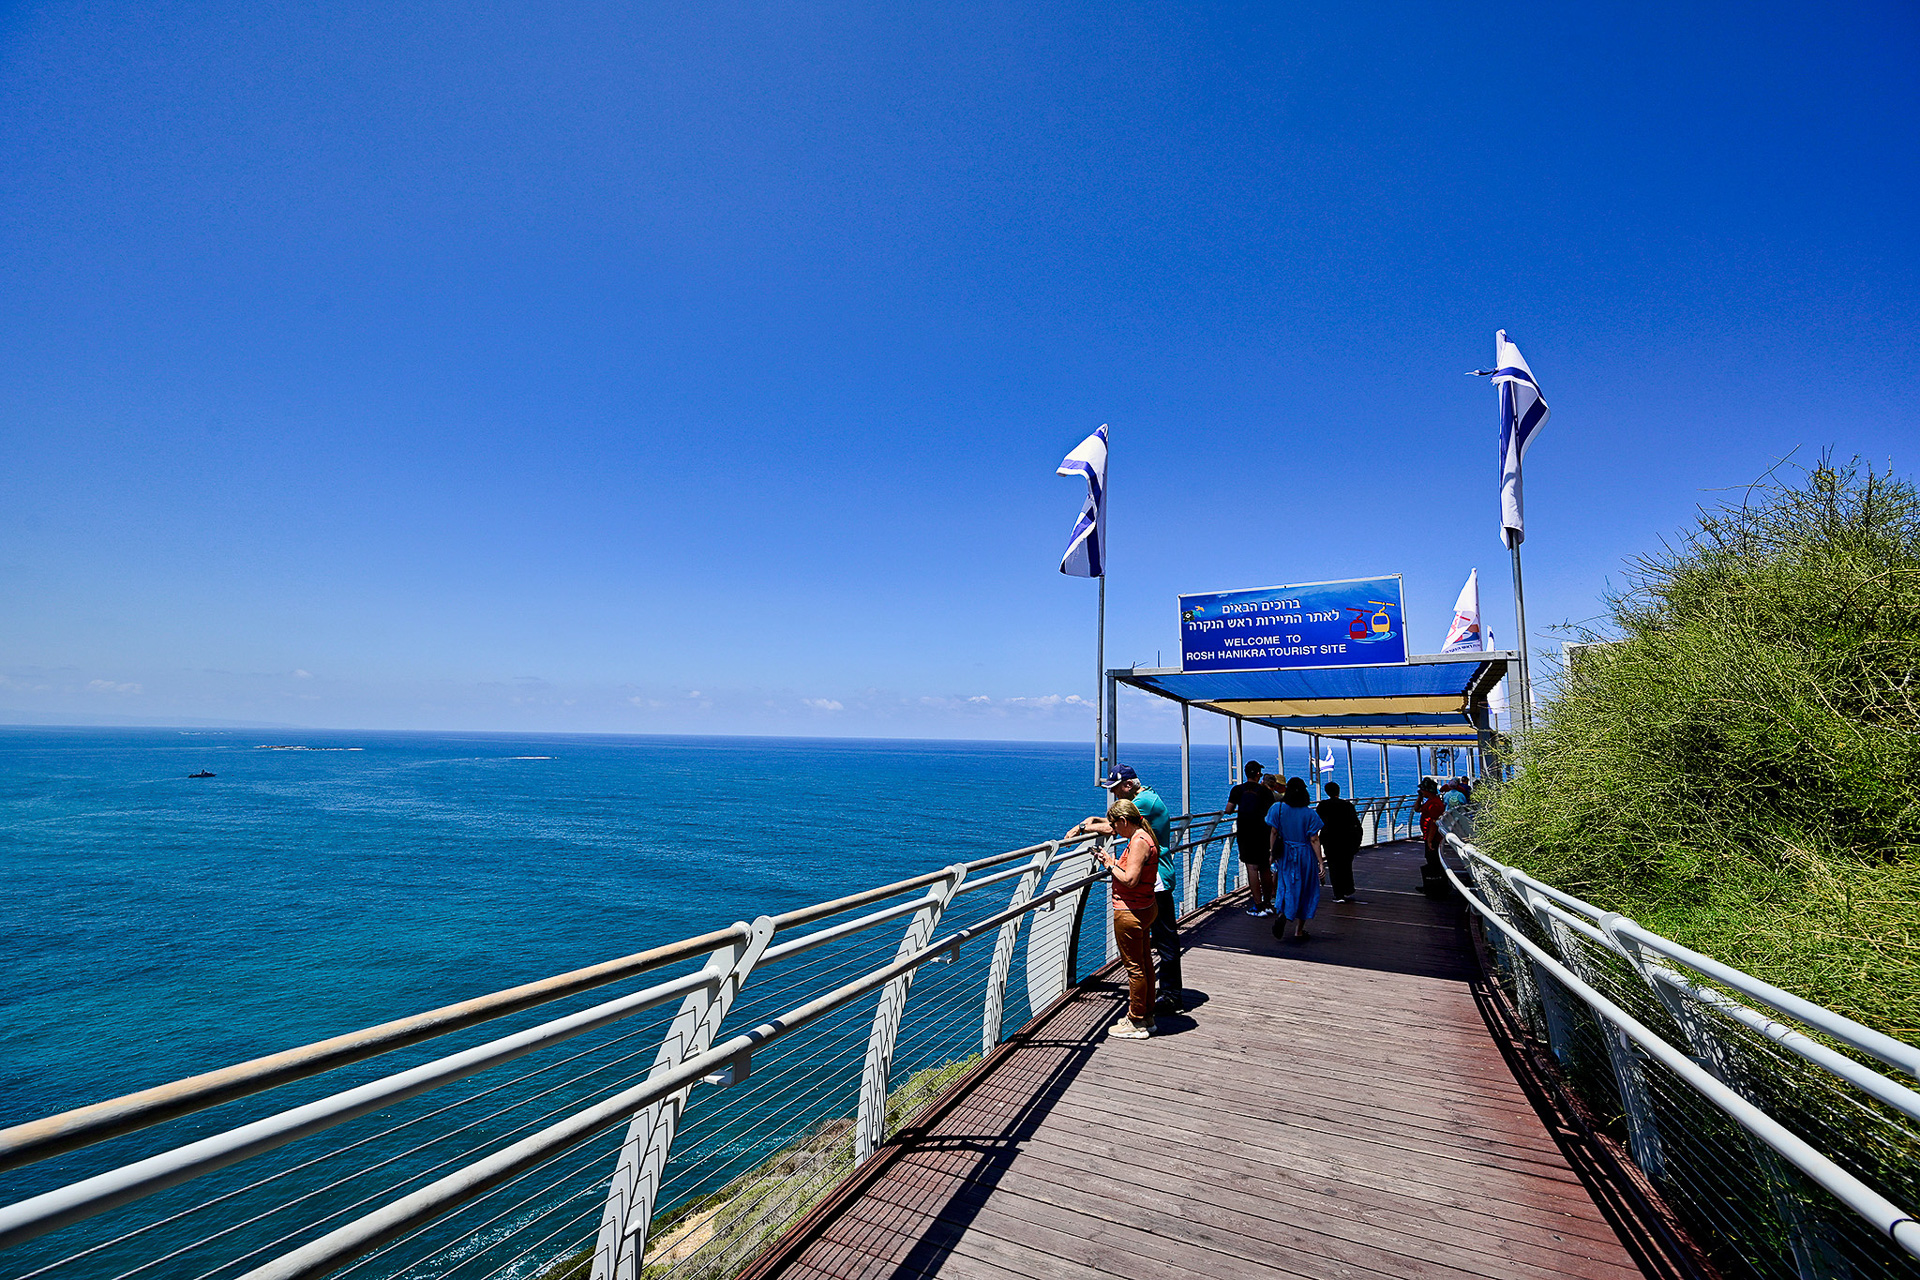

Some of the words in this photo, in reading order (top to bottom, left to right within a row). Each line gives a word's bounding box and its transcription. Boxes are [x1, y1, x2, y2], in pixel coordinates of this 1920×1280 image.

[1221, 603, 1258, 614] הבאים
[1261, 599, 1301, 612] ברוכים
[1255, 614, 1302, 627] התיירות
[1305, 608, 1340, 623] לאתר
[1188, 619, 1224, 633] הנקרה
[1227, 617, 1253, 628] ראש
[1223, 635, 1281, 647] WELCOME
[1285, 634, 1302, 644] TO
[1186, 651, 1215, 661] ROSH
[1217, 647, 1267, 659] HANIKRA
[1267, 645, 1318, 657] TOURIST
[1320, 643, 1347, 655] SITE
